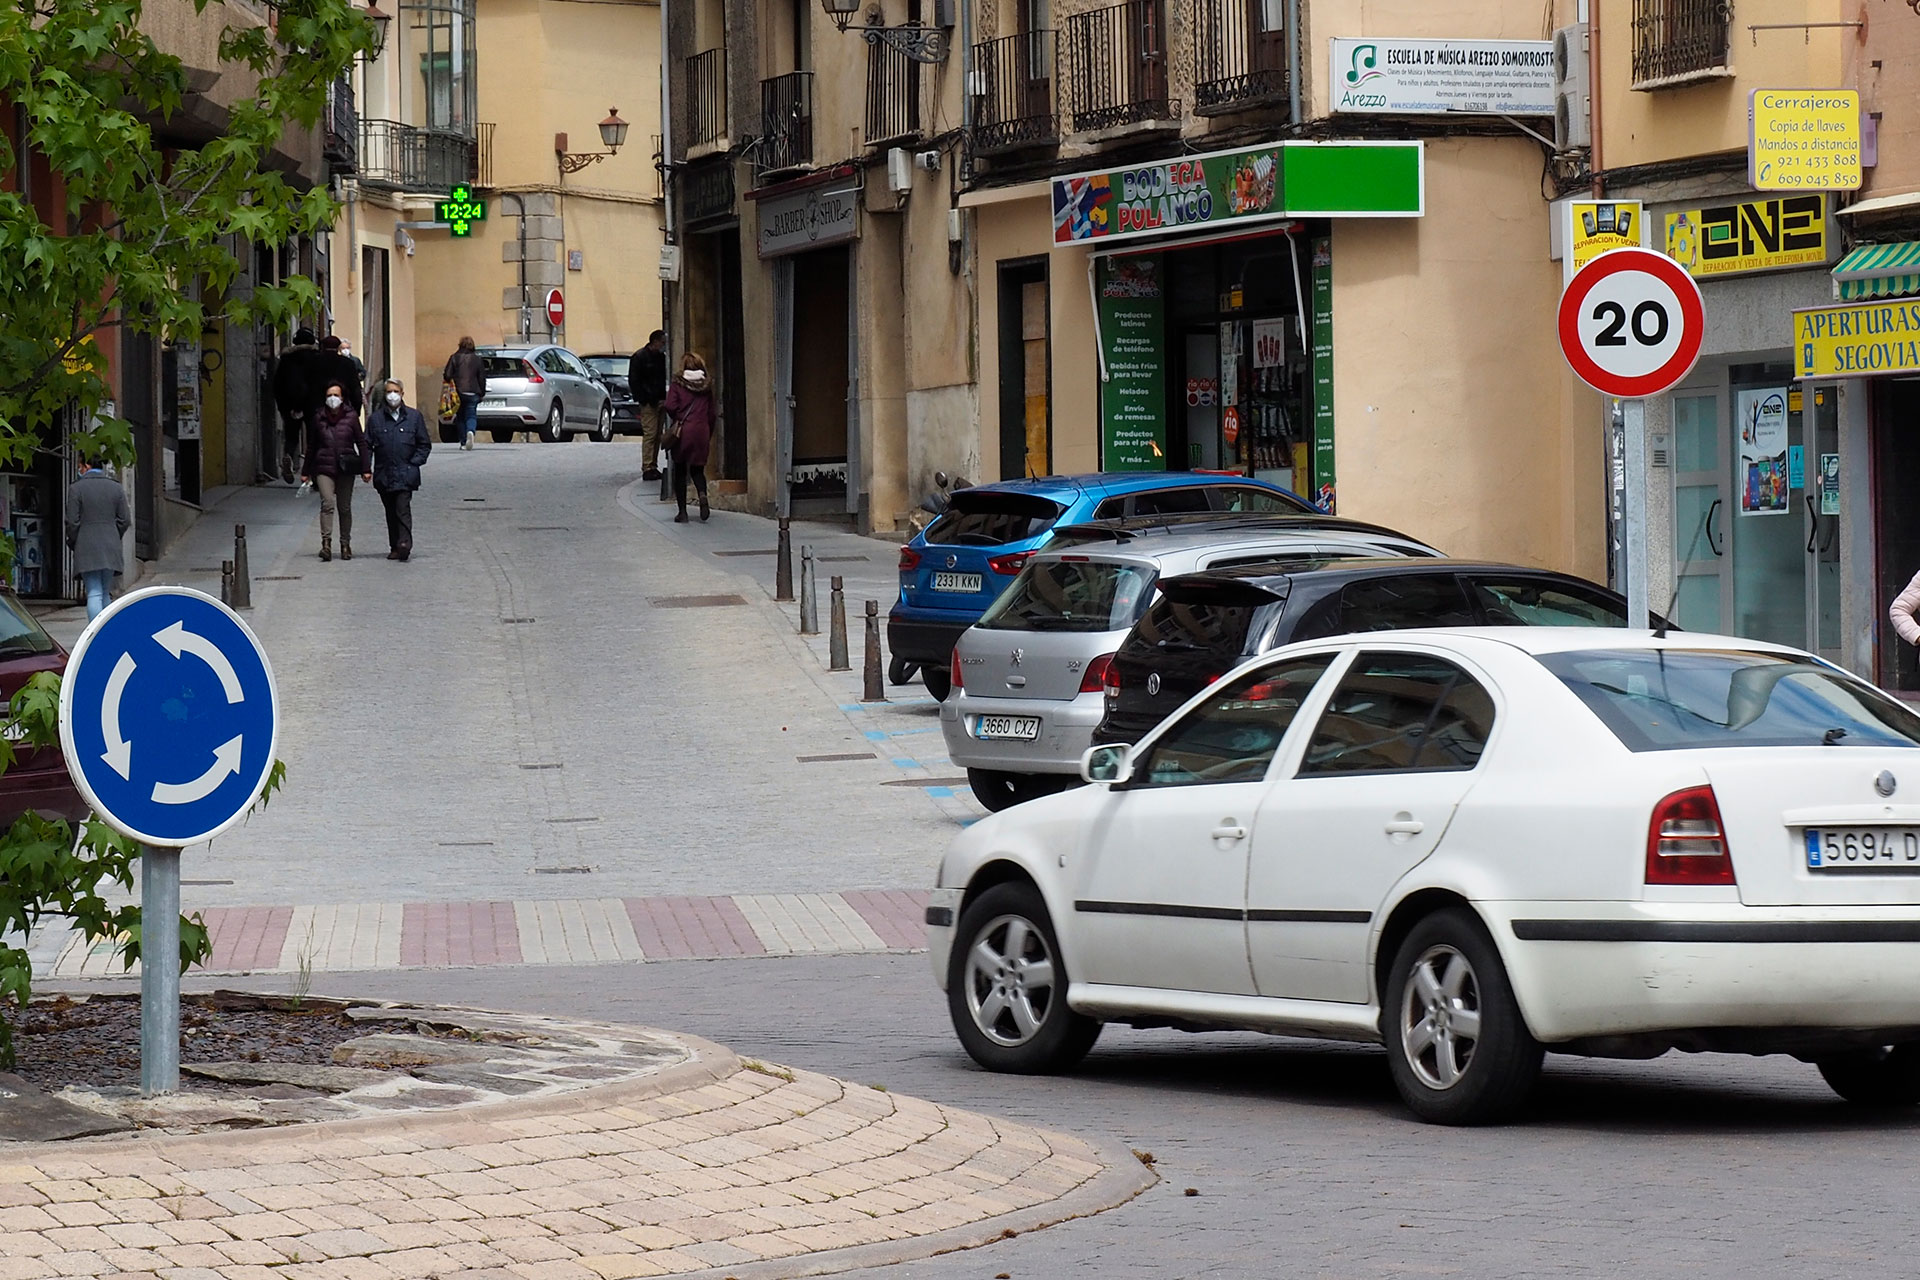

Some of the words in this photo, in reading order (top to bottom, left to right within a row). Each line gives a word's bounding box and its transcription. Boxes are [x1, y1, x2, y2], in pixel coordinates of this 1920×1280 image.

[1387, 49, 1420, 64] ESCUELA
[1424, 50, 1434, 65] DE
[1437, 44, 1466, 65] MÚSICA
[1468, 50, 1499, 66] AREZZO
[1341, 90, 1386, 107] Arezzo
[1763, 95, 1850, 111] Cerrajeros
[1769, 119, 1798, 134] Copia
[1801, 119, 1814, 132] de
[1817, 119, 1845, 132] llaves
[1758, 138, 1798, 150] Mandos
[1801, 141, 1807, 150] a
[1811, 137, 1857, 150] distancia
[1778, 156, 1800, 168] 921
[1805, 156, 1829, 168] 433
[1833, 154, 1857, 166] 808
[1122, 159, 1207, 202] BODEGA
[1778, 173, 1802, 186] 609
[1806, 174, 1829, 186] 045
[1834, 172, 1857, 186] 850
[441, 203, 481, 219] 12:24
[774, 208, 805, 237] BARBER
[820, 199, 841, 225] SHOP
[1117, 189, 1213, 233] POLANCO
[1701, 195, 1821, 260] ONE
[1738, 260, 1743, 268] Y
[1744, 258, 1763, 268] VENTA
[1765, 257, 1772, 266] DE
[1592, 300, 1668, 346] 20
[1801, 304, 1920, 339] APERTURAS
[1834, 340, 1920, 371] SEGOVIA
[1224, 411, 1237, 429] ria
[937, 574, 959, 587] 2331
[961, 575, 979, 589] KKN
[984, 718, 1010, 734] 3660
[1014, 720, 1035, 735] CXZ
[1825, 833, 1893, 861] 5694
